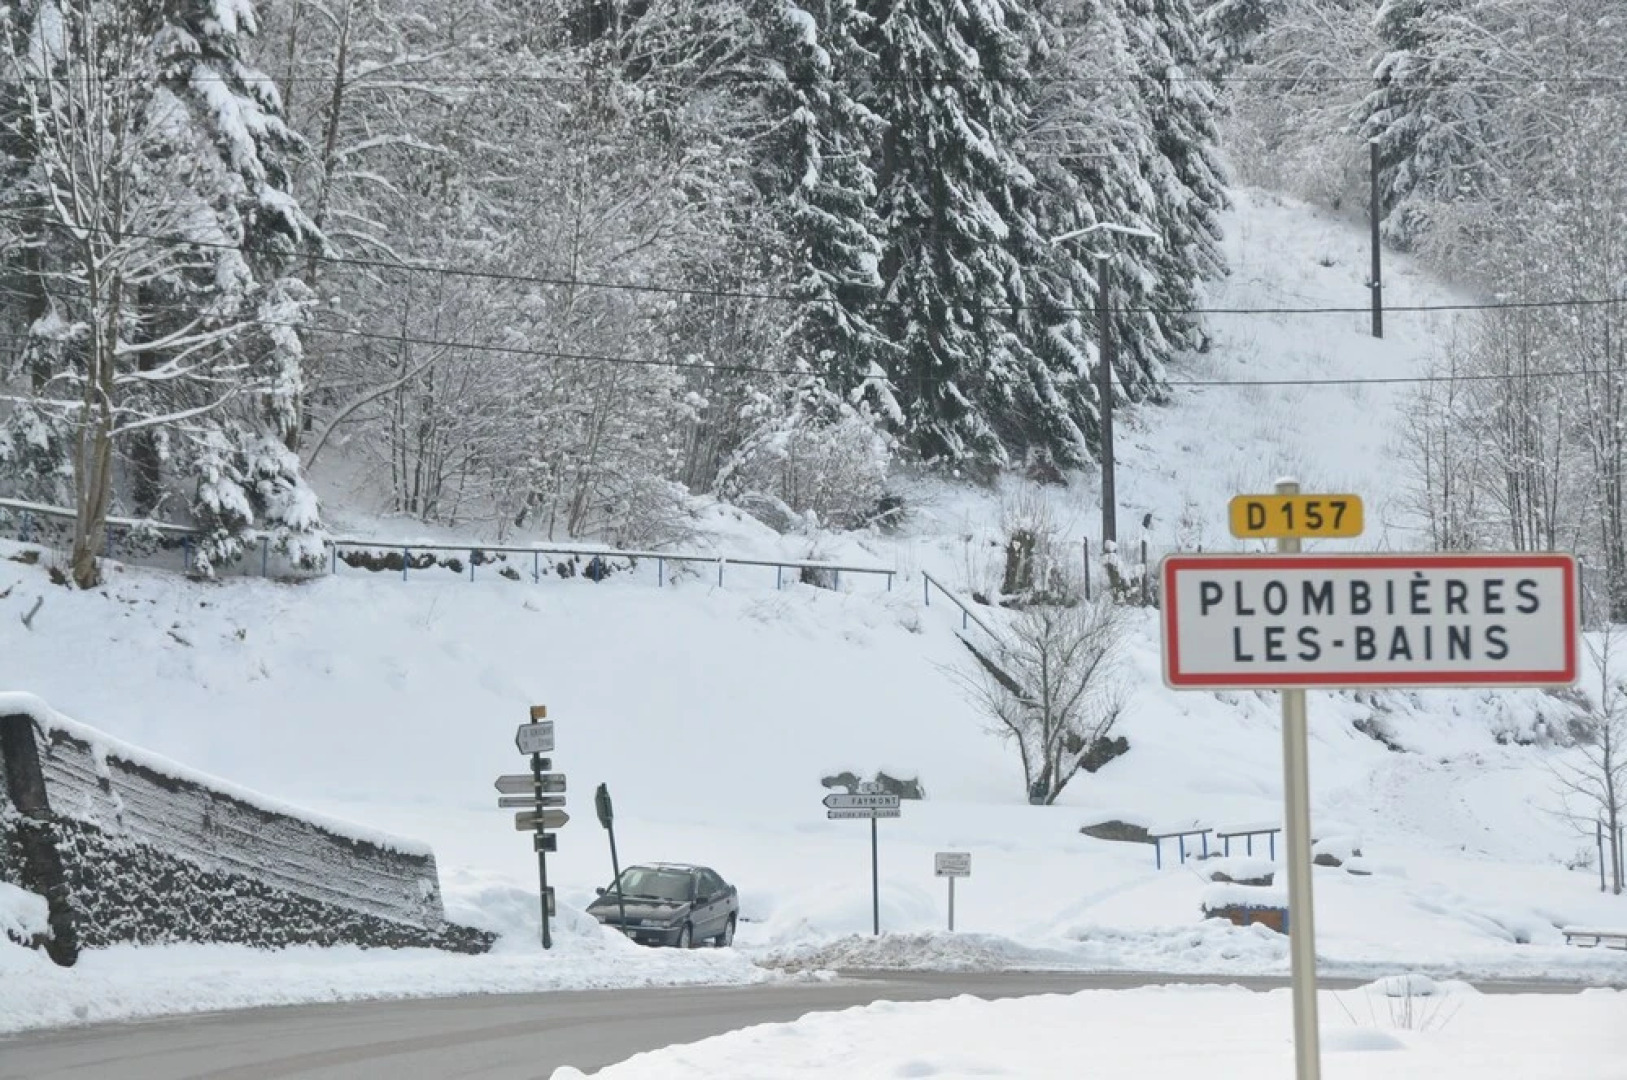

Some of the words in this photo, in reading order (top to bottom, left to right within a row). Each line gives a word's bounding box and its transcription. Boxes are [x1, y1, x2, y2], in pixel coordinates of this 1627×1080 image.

[1247, 502, 1266, 530] D
[1281, 501, 1347, 530] 157
[1200, 572, 1540, 616] PLOMBIÈRES
[1233, 625, 1509, 662] LES-BAINS
[852, 796, 896, 805] FAYMONT
